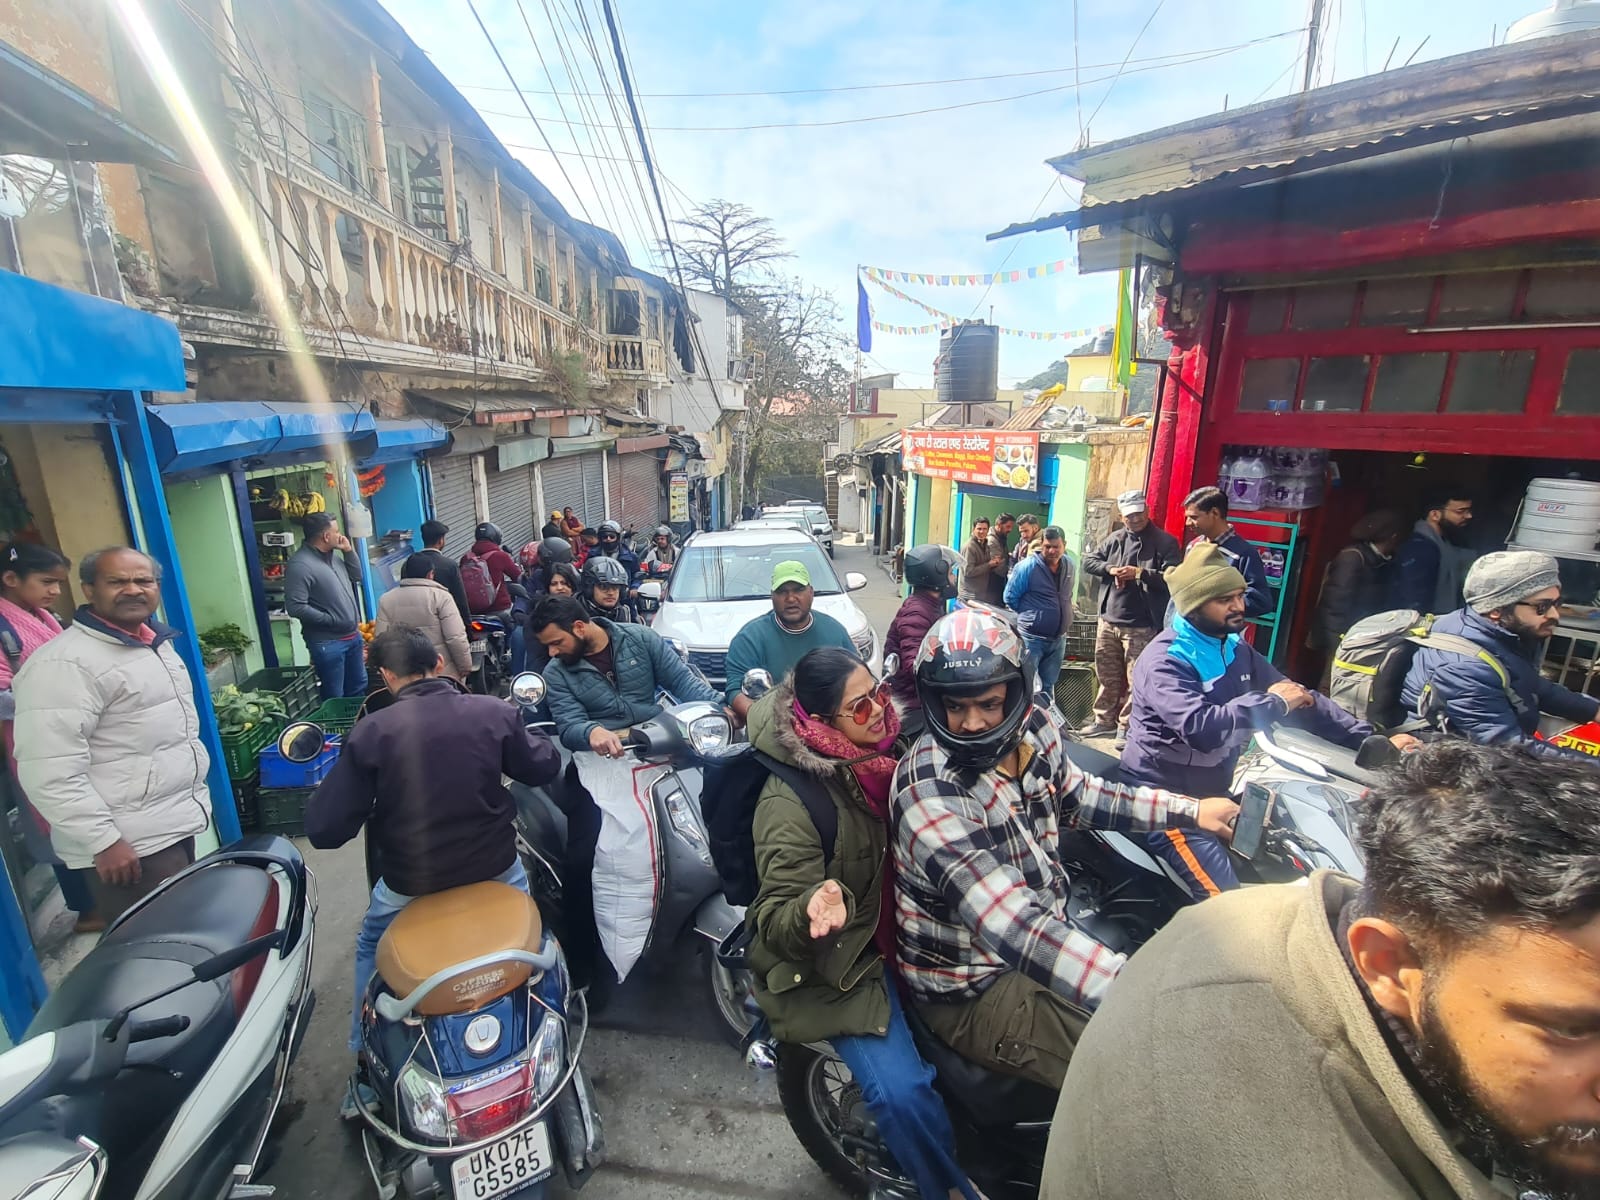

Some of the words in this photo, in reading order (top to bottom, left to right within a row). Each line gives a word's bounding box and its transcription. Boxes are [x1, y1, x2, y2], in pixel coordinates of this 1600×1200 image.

[943, 657, 982, 669] JUSTLY
[470, 1128, 534, 1174] UK07F
[474, 1151, 540, 1197] G5585
